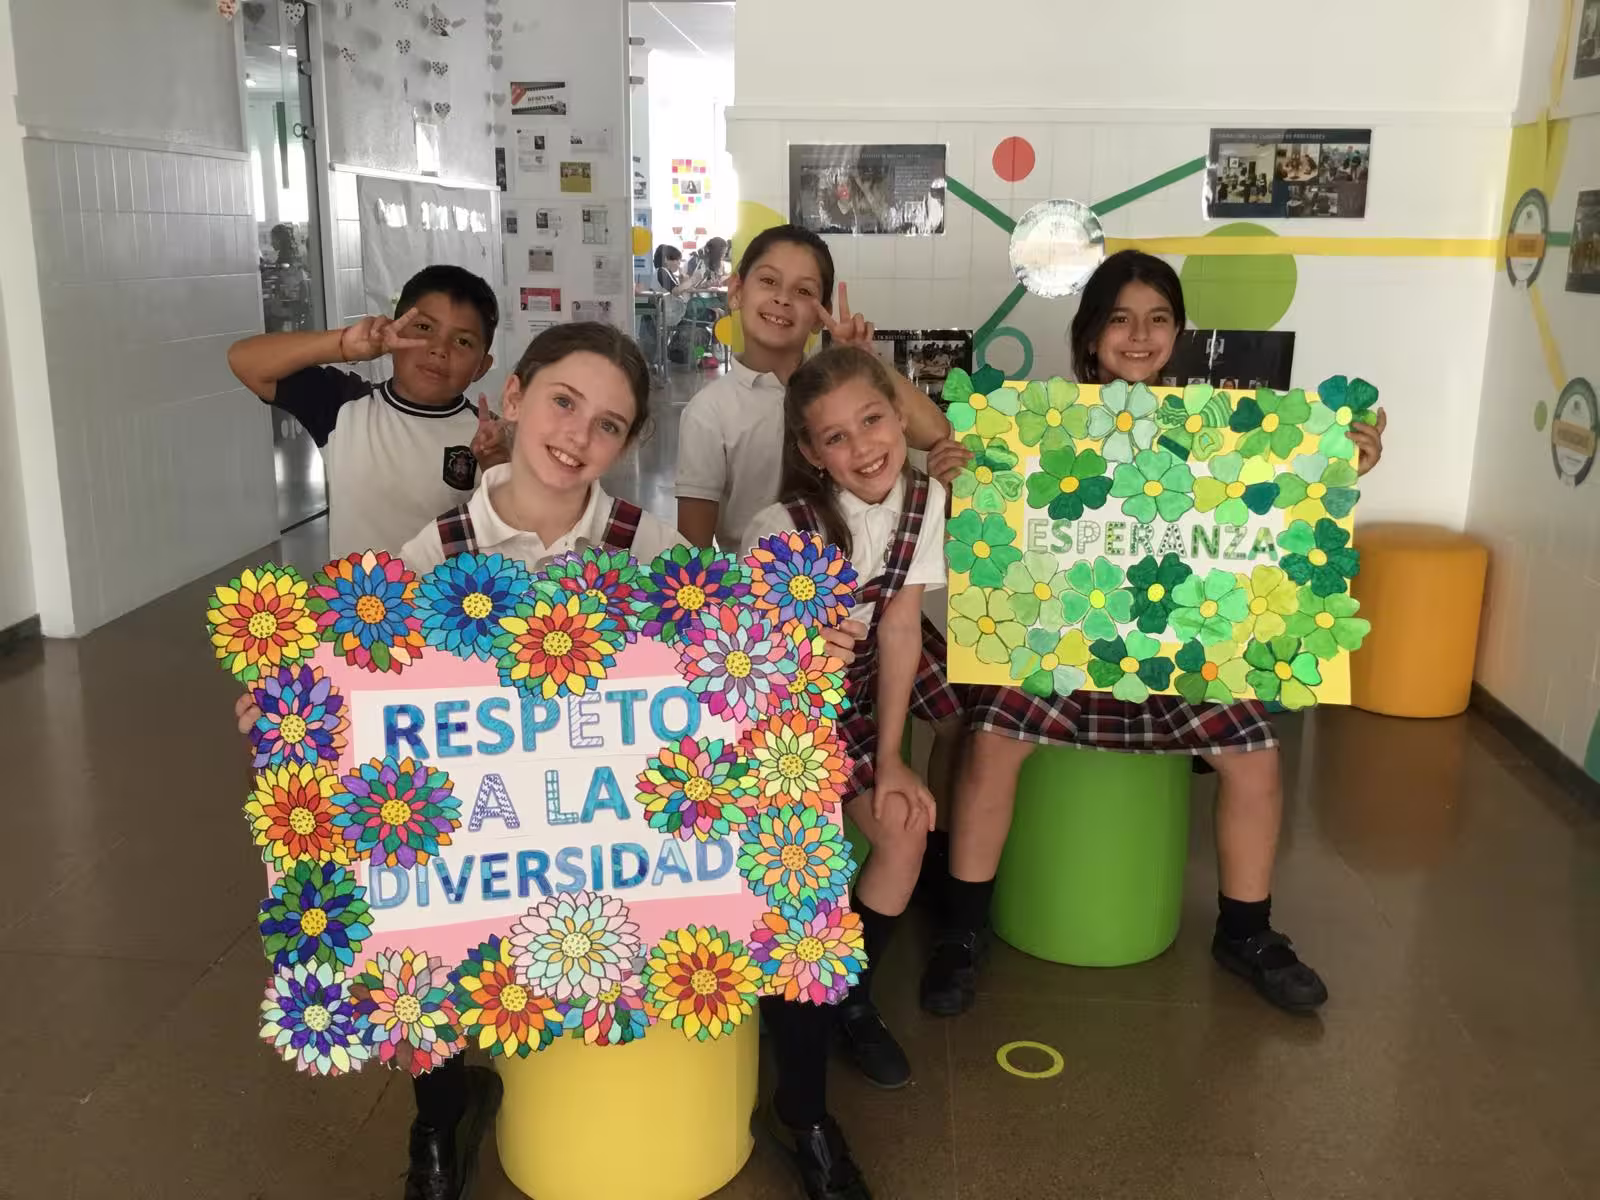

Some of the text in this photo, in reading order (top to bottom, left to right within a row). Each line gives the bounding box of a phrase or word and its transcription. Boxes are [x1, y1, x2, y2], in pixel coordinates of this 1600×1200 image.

[1027, 518, 1279, 561] ESPERANZA
[383, 686, 701, 761] RESPETO
[468, 766, 631, 832] A LA
[369, 837, 734, 909] DIVERSIDAD
